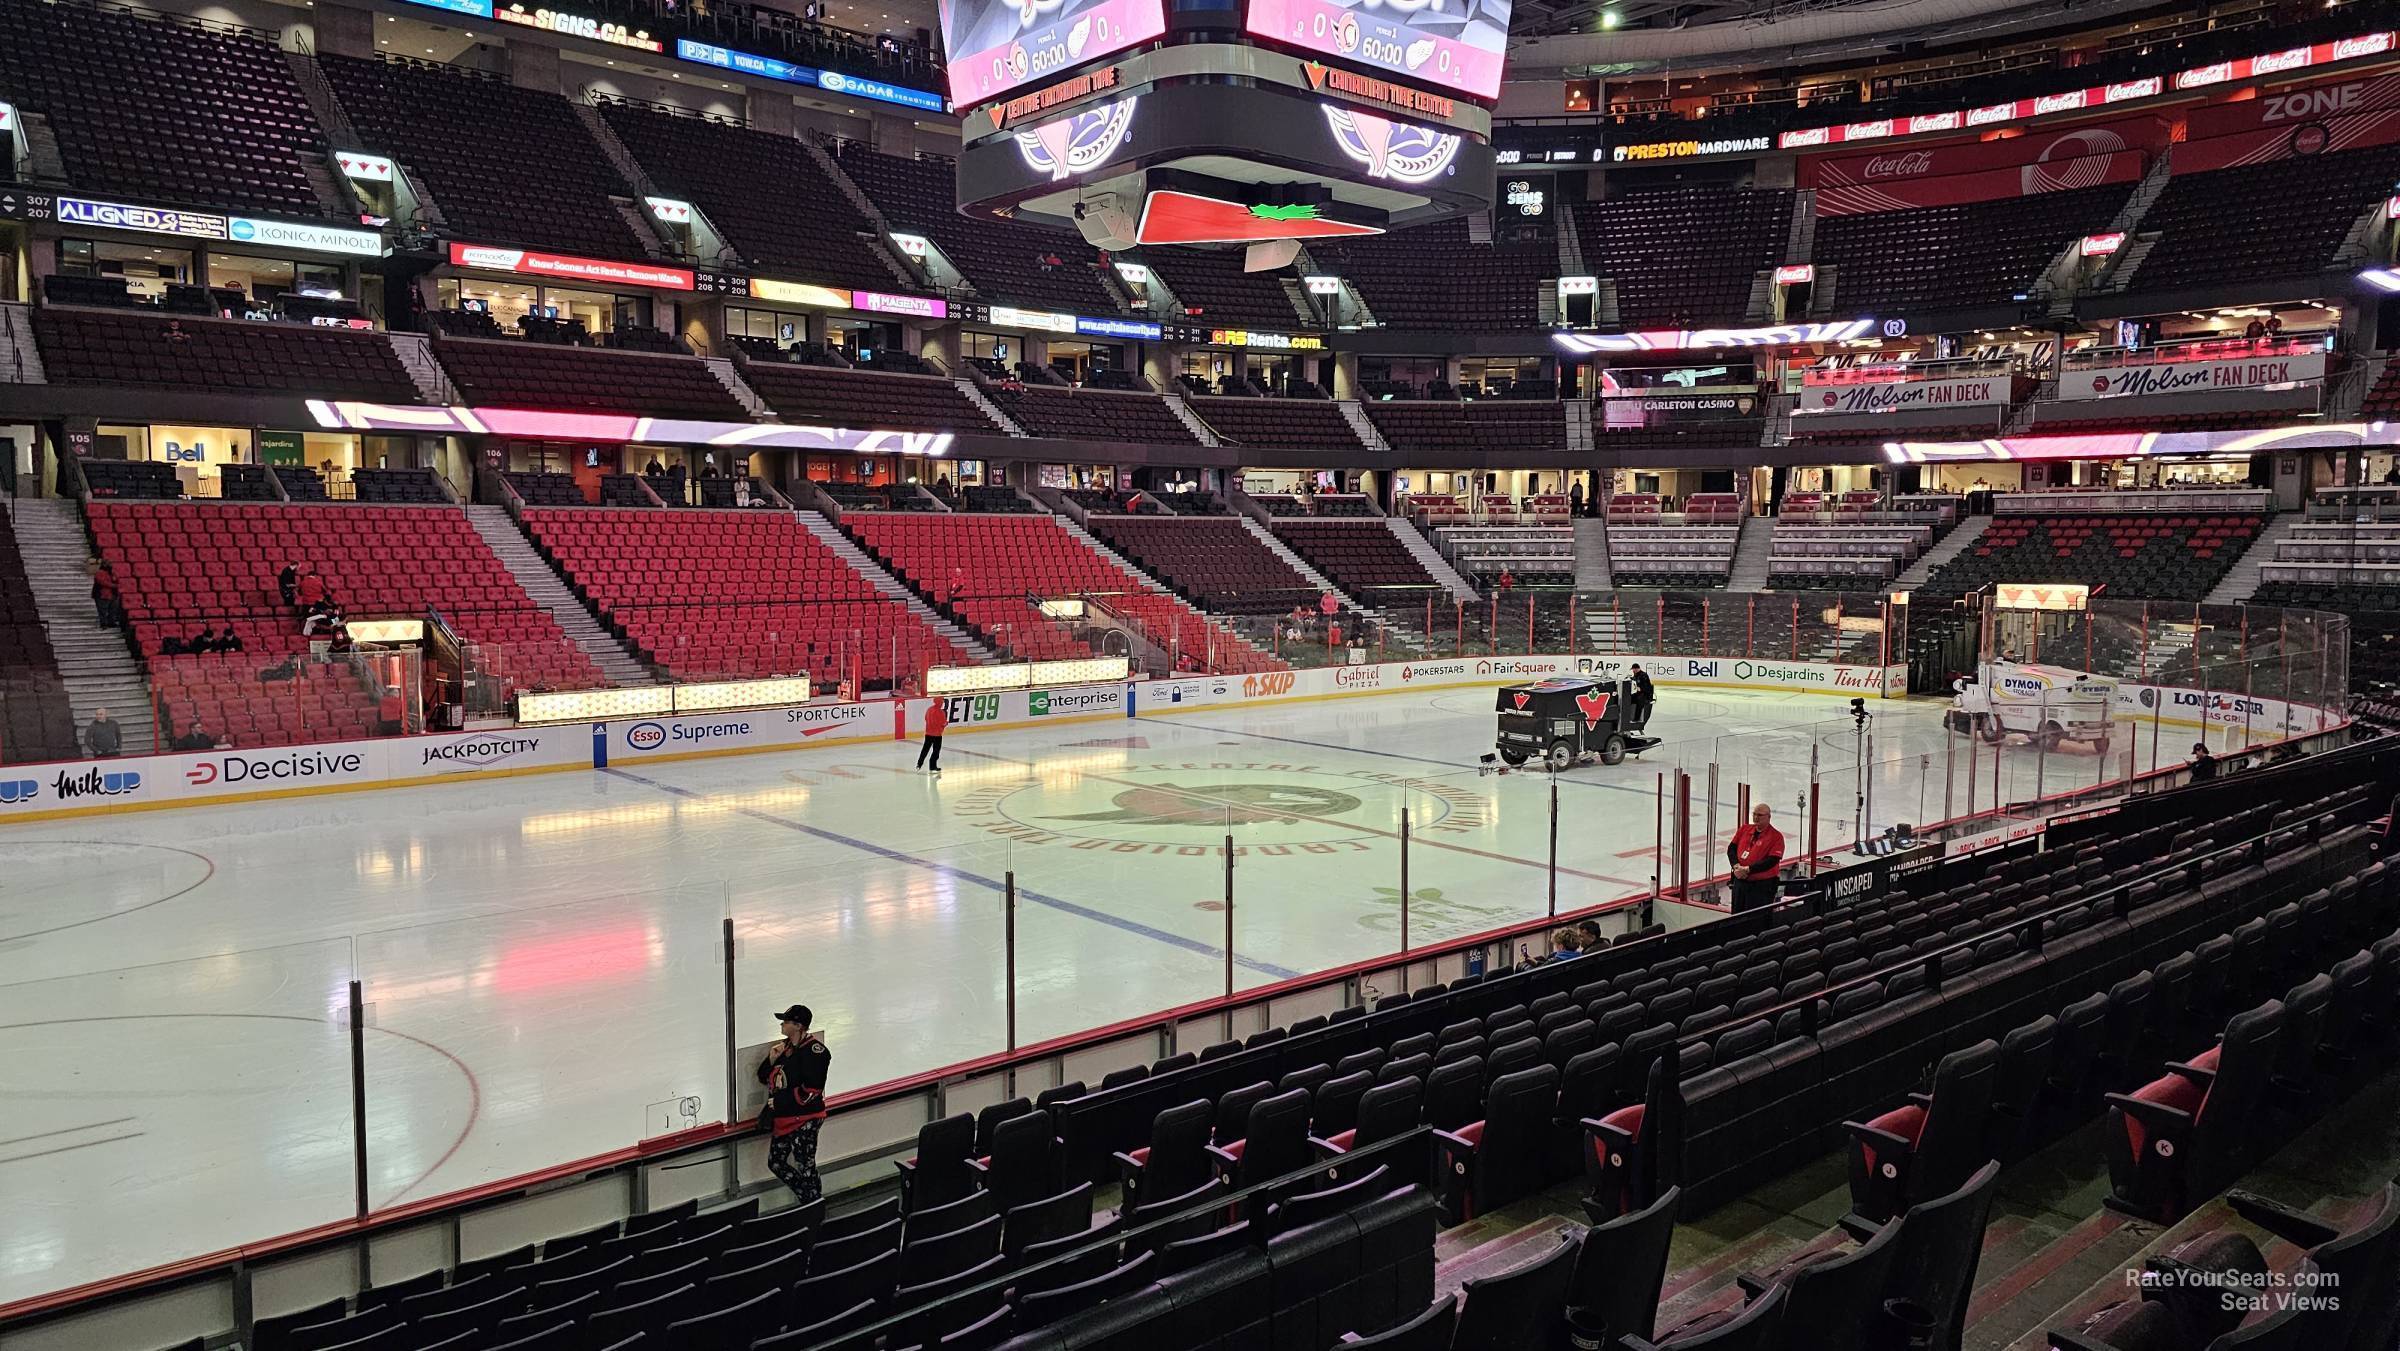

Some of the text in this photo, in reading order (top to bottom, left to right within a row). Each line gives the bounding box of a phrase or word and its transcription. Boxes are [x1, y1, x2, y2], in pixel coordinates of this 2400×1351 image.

[534, 8, 628, 44] SIGNS.CA
[1097, 17, 1109, 42] 0
[1313, 13, 1327, 38] 0
[1362, 37, 1402, 66] 60:00
[2342, 35, 2389, 56] Coca-Cola
[1032, 43, 1066, 73] 60:00
[1438, 49, 1449, 73] 0
[2256, 50, 2306, 74] Coca-Cola
[992, 58, 1004, 80] 0
[2180, 64, 2227, 88] Coca-Cola
[844, 78, 894, 99] GADAR
[1006, 66, 1116, 120] CENTRE CANADIAN TIRE
[1329, 70, 1454, 118] CANADIAN TIRE CENTRE
[2109, 79, 2157, 101] Coca-Cola
[2037, 92, 2082, 114] Coca-Cola
[2262, 83, 2363, 121] ZONE
[1913, 114, 1954, 133] Coca-Cola
[1970, 104, 2010, 124] Coca-Cola
[1785, 130, 1823, 148] Coca-Cola
[1848, 122, 1888, 140] Coca-Cola
[1628, 137, 1770, 161] PRESTON HARDWARE
[1865, 151, 1933, 178] Coca-Cola
[1507, 181, 1529, 194] GO
[26, 195, 50, 207] 307
[1507, 191, 1543, 206] SENS
[27, 207, 51, 219] 207
[60, 203, 160, 230] ALIGNED
[1520, 204, 1543, 216] GO
[260, 226, 381, 250] KONICA MINOLTA
[697, 274, 713, 283] 308
[697, 283, 713, 292] 208
[731, 278, 746, 287] 309
[731, 287, 747, 296] 209
[881, 293, 931, 311] MAGENTA
[976, 306, 988, 314] 310
[948, 311, 962, 320] 209
[976, 314, 988, 322] 210
[2112, 363, 2289, 395] Molson FAN DECK
[1644, 400, 1695, 411] CARLETON
[1697, 399, 1735, 409] CASINO
[1840, 383, 1990, 410] Molson FAN DECK
[70, 434, 90, 443] 105
[166, 442, 204, 462] Bell
[486, 449, 501, 458] 106
[1336, 667, 1380, 686] Gabriel
[1413, 665, 1464, 677] POKERSTARS
[1689, 661, 1718, 677] Bell
[1757, 666, 1825, 682] Desjardins
[1833, 668, 1862, 686] Tim
[1258, 672, 1296, 696] SKIP
[1350, 681, 1380, 689] PIZZA
[2005, 678, 2042, 690] DYMON
[1032, 691, 1118, 709] enterprise
[787, 707, 866, 723] SPORTCHEK
[634, 723, 749, 742] Esso Supreme
[422, 738, 540, 765] JACKPOTCITY
[224, 752, 361, 783] Decisive
